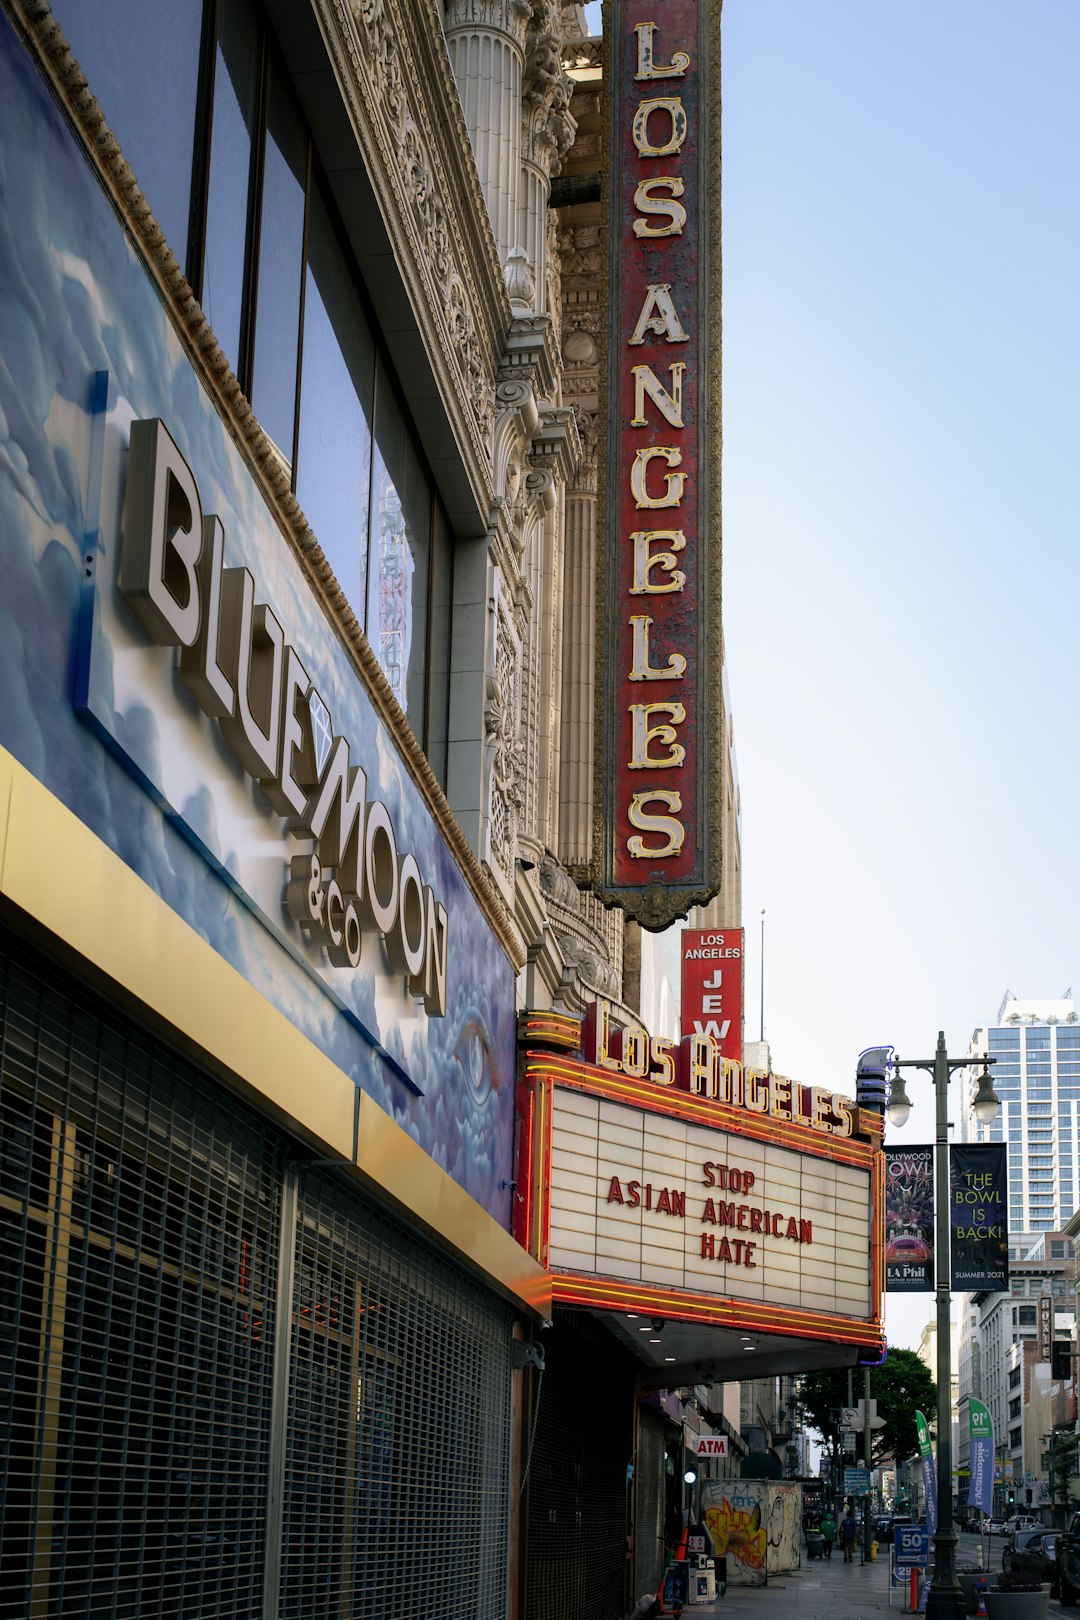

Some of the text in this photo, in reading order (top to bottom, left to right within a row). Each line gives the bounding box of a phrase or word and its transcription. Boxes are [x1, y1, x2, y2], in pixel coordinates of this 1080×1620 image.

[626, 22, 691, 859] LOS ANGELES
[122, 417, 449, 1017] BLUE MOON
[700, 934, 725, 946] LOS
[685, 948, 740, 959] ANGELES
[590, 1000, 676, 1085] LOS
[885, 1152, 932, 1161] OLLYWOOD
[888, 1161, 932, 1177] OWL
[702, 1161, 756, 1196] STOP
[965, 1173, 993, 1187] THE
[955, 1191, 1002, 1204] BOWL
[607, 1175, 813, 1245] ASIAN AMERICAN
[972, 1208, 985, 1221] IS
[956, 1226, 1002, 1239] BACK!
[700, 1232, 757, 1268] HATE
[887, 1266, 925, 1278] LA Phil
[955, 1271, 1005, 1279] SUMMER 2021
[697, 1440, 725, 1454] ATM
